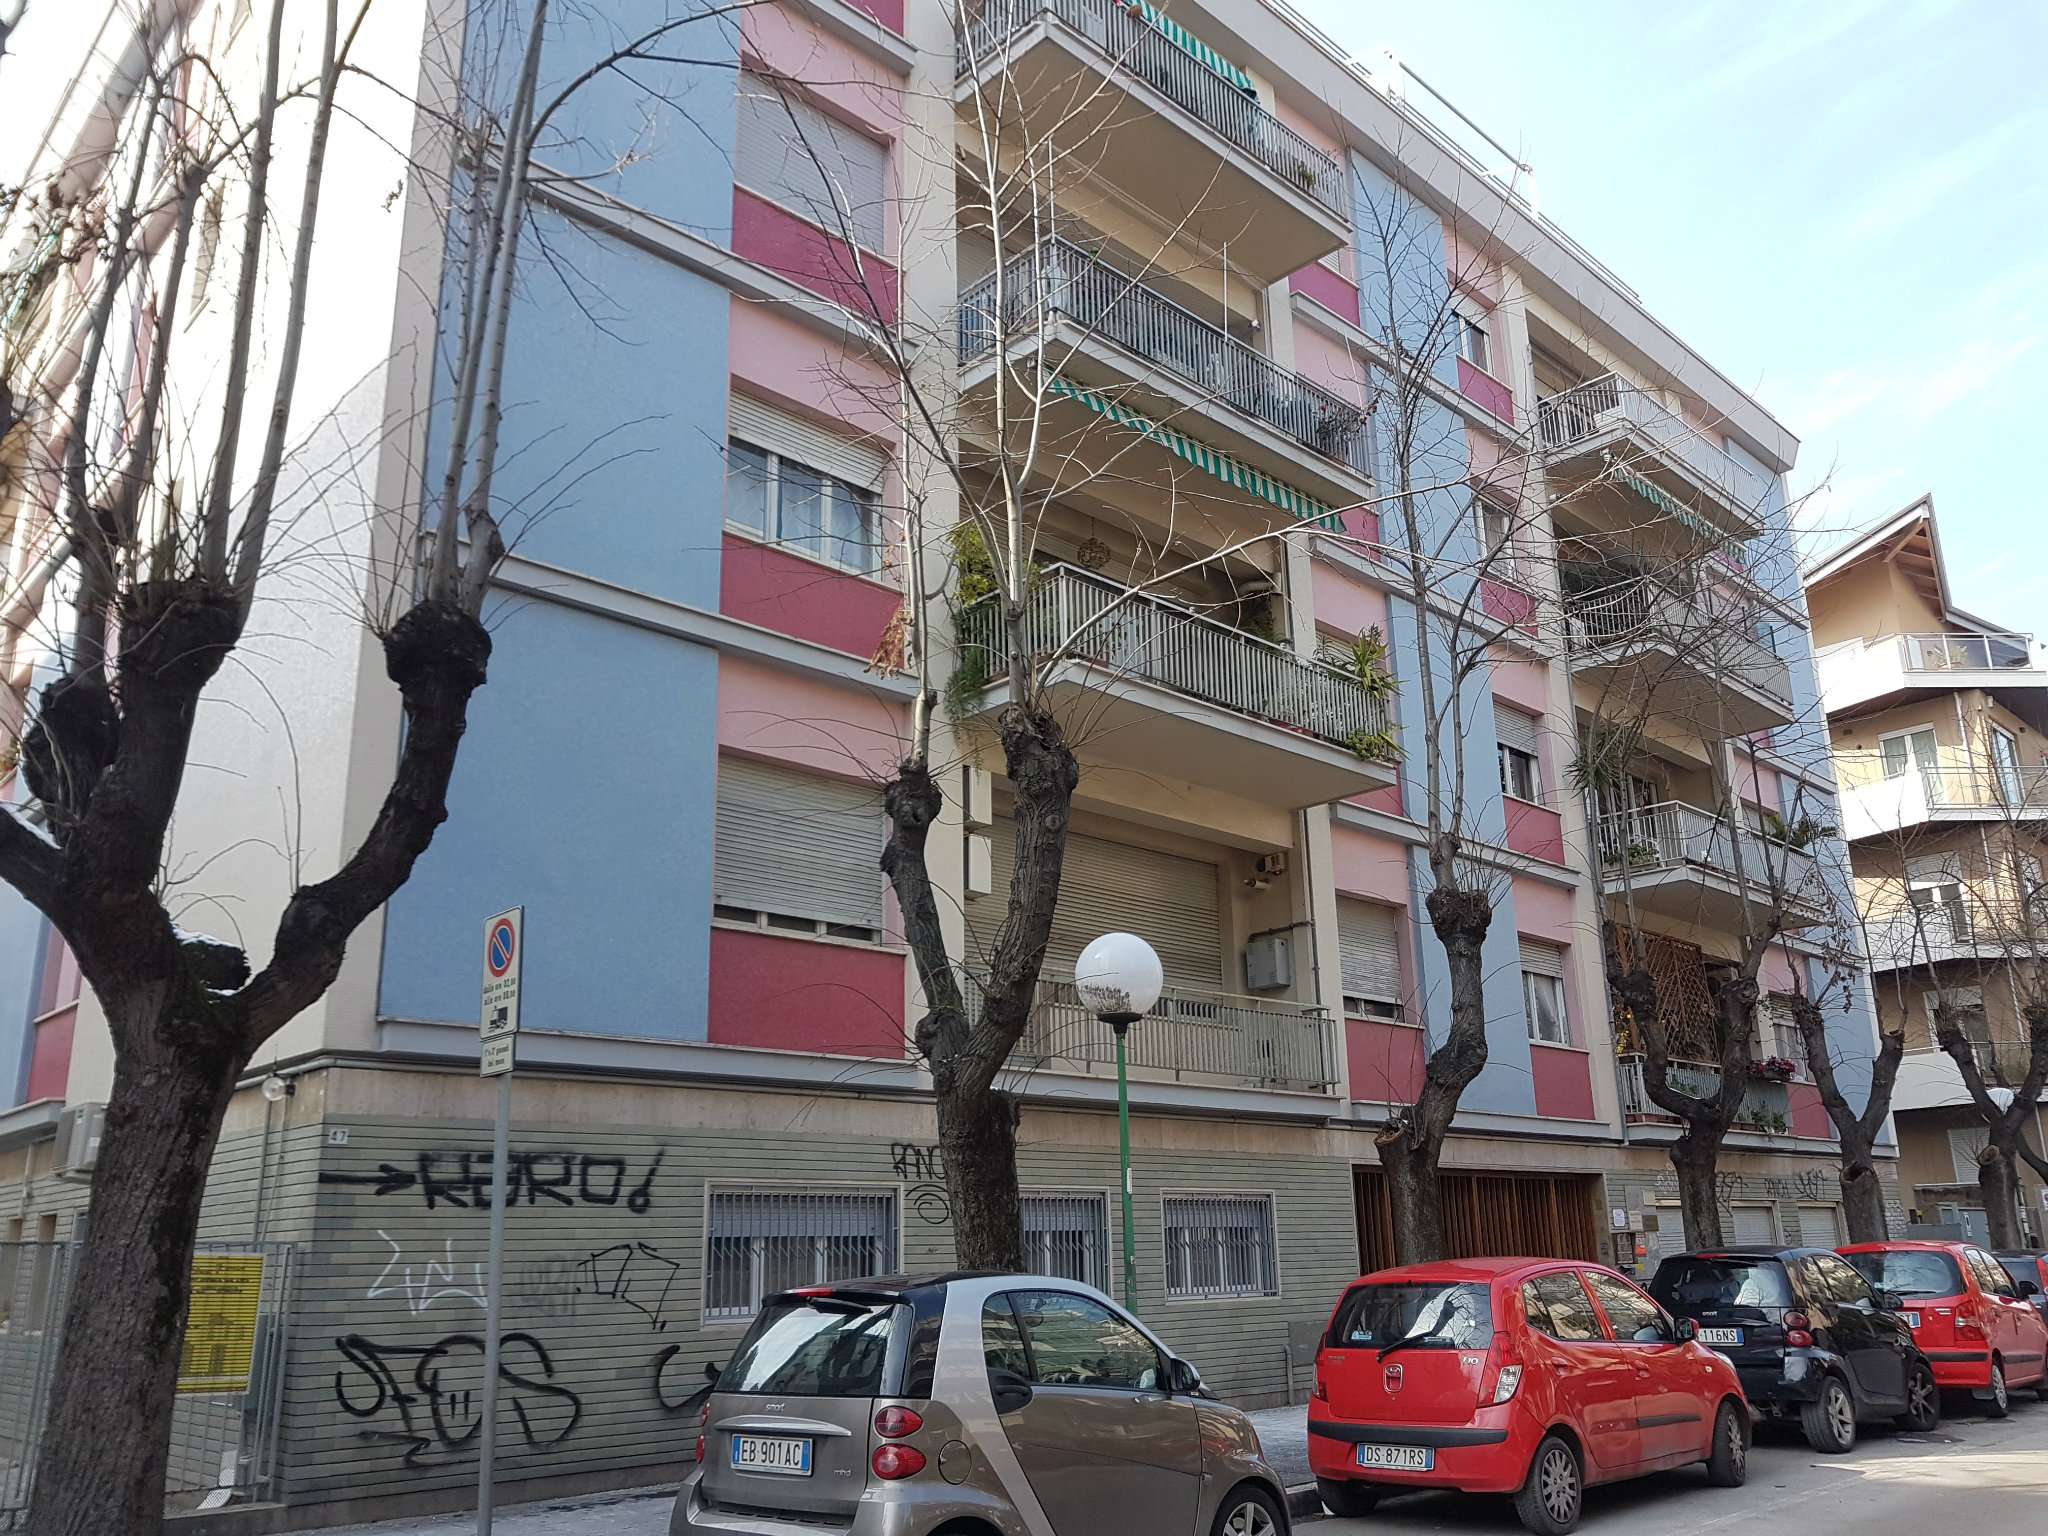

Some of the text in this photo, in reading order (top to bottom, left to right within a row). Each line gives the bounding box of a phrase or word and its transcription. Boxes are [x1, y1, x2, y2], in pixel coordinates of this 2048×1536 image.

[330, 1130, 347, 1142] 47
[742, 1440, 757, 1463] EB
[1366, 1446, 1381, 1463] DS
[1386, 1448, 1424, 1466] 871RS
